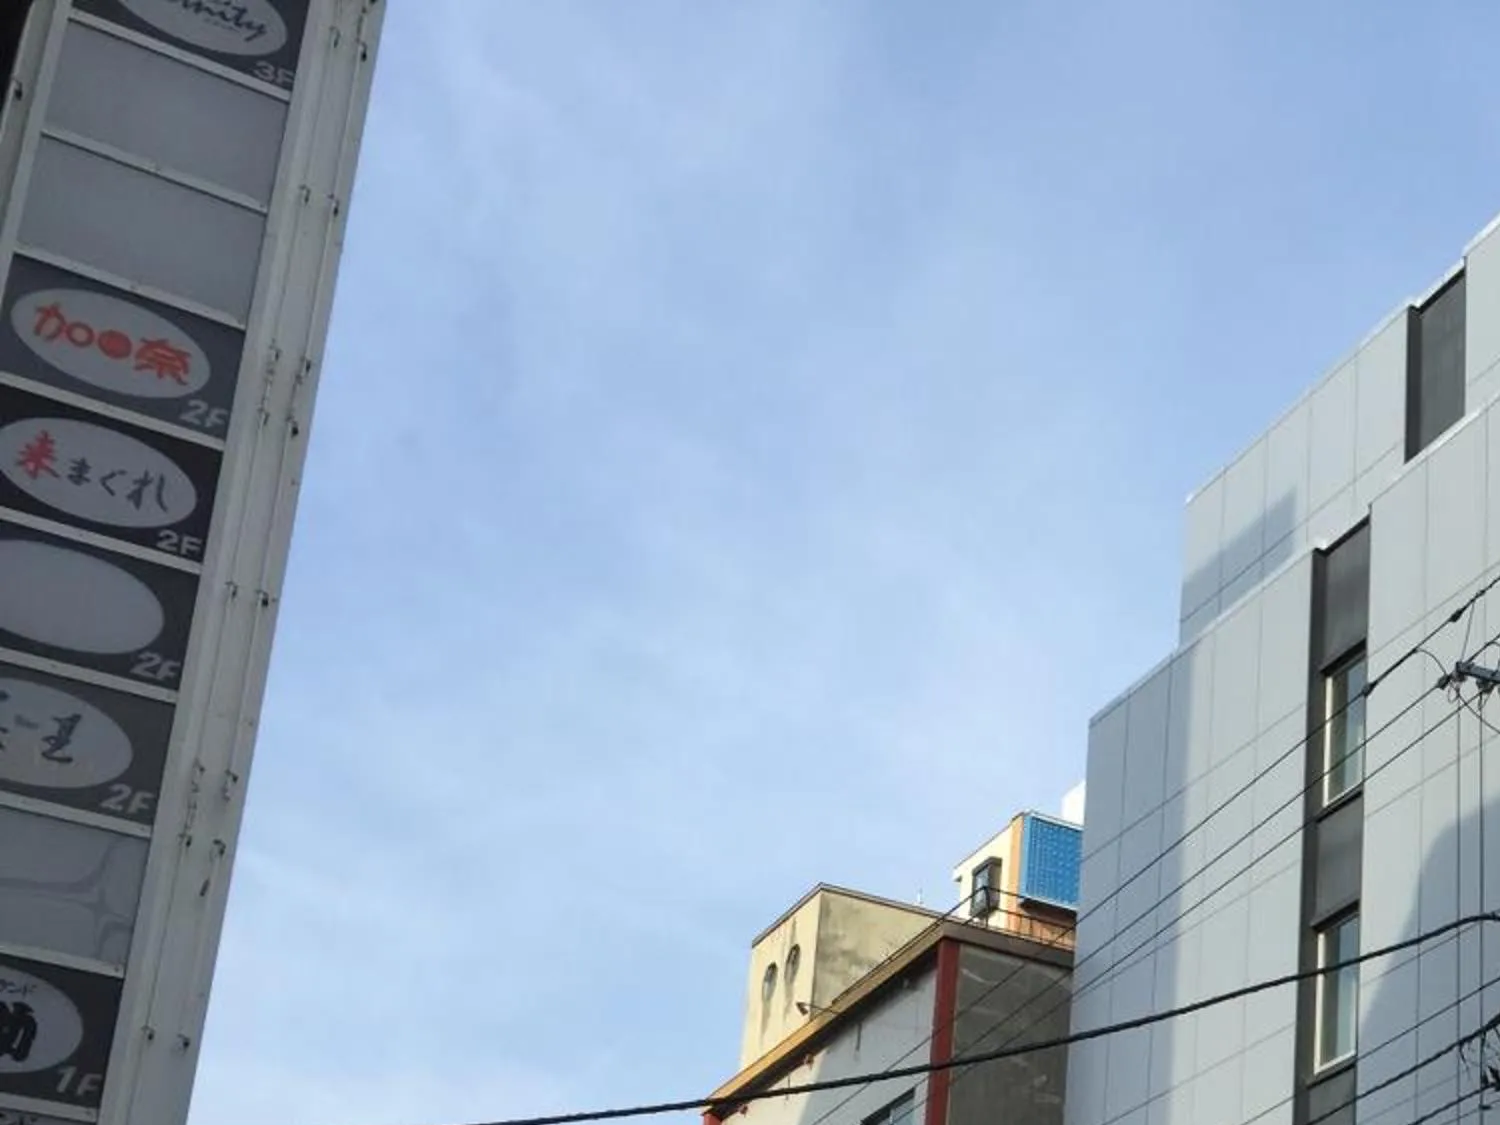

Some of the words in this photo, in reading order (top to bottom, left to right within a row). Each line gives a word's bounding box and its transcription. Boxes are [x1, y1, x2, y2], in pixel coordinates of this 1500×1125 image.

[253, 60, 295, 85] 3F
[179, 399, 228, 431] 2F
[156, 529, 202, 556] 2F
[130, 651, 180, 682] 2F
[100, 783, 156, 814] 2F
[55, 1065, 103, 1097] 1F
